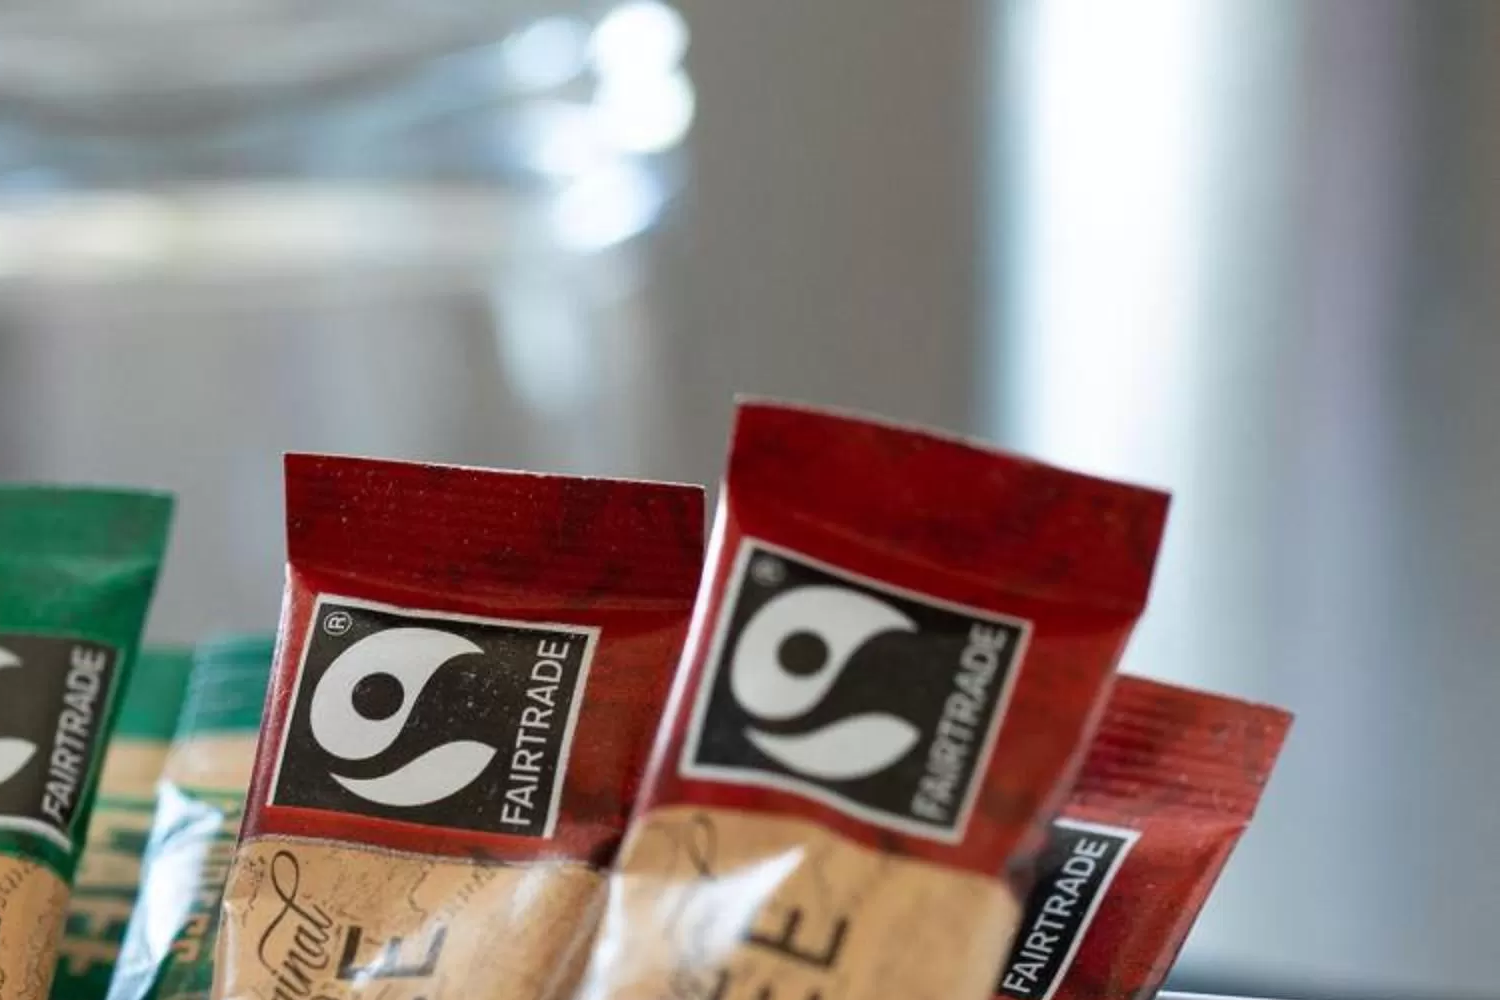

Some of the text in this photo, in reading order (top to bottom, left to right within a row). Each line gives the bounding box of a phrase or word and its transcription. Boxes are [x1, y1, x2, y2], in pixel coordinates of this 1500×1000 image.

[41, 646, 106, 824] FAIRTRADE
[500, 638, 570, 827] FAIRTRADE
[911, 622, 1010, 821] FAIRTRADE
[1002, 836, 1108, 995] FAIRTRADE
